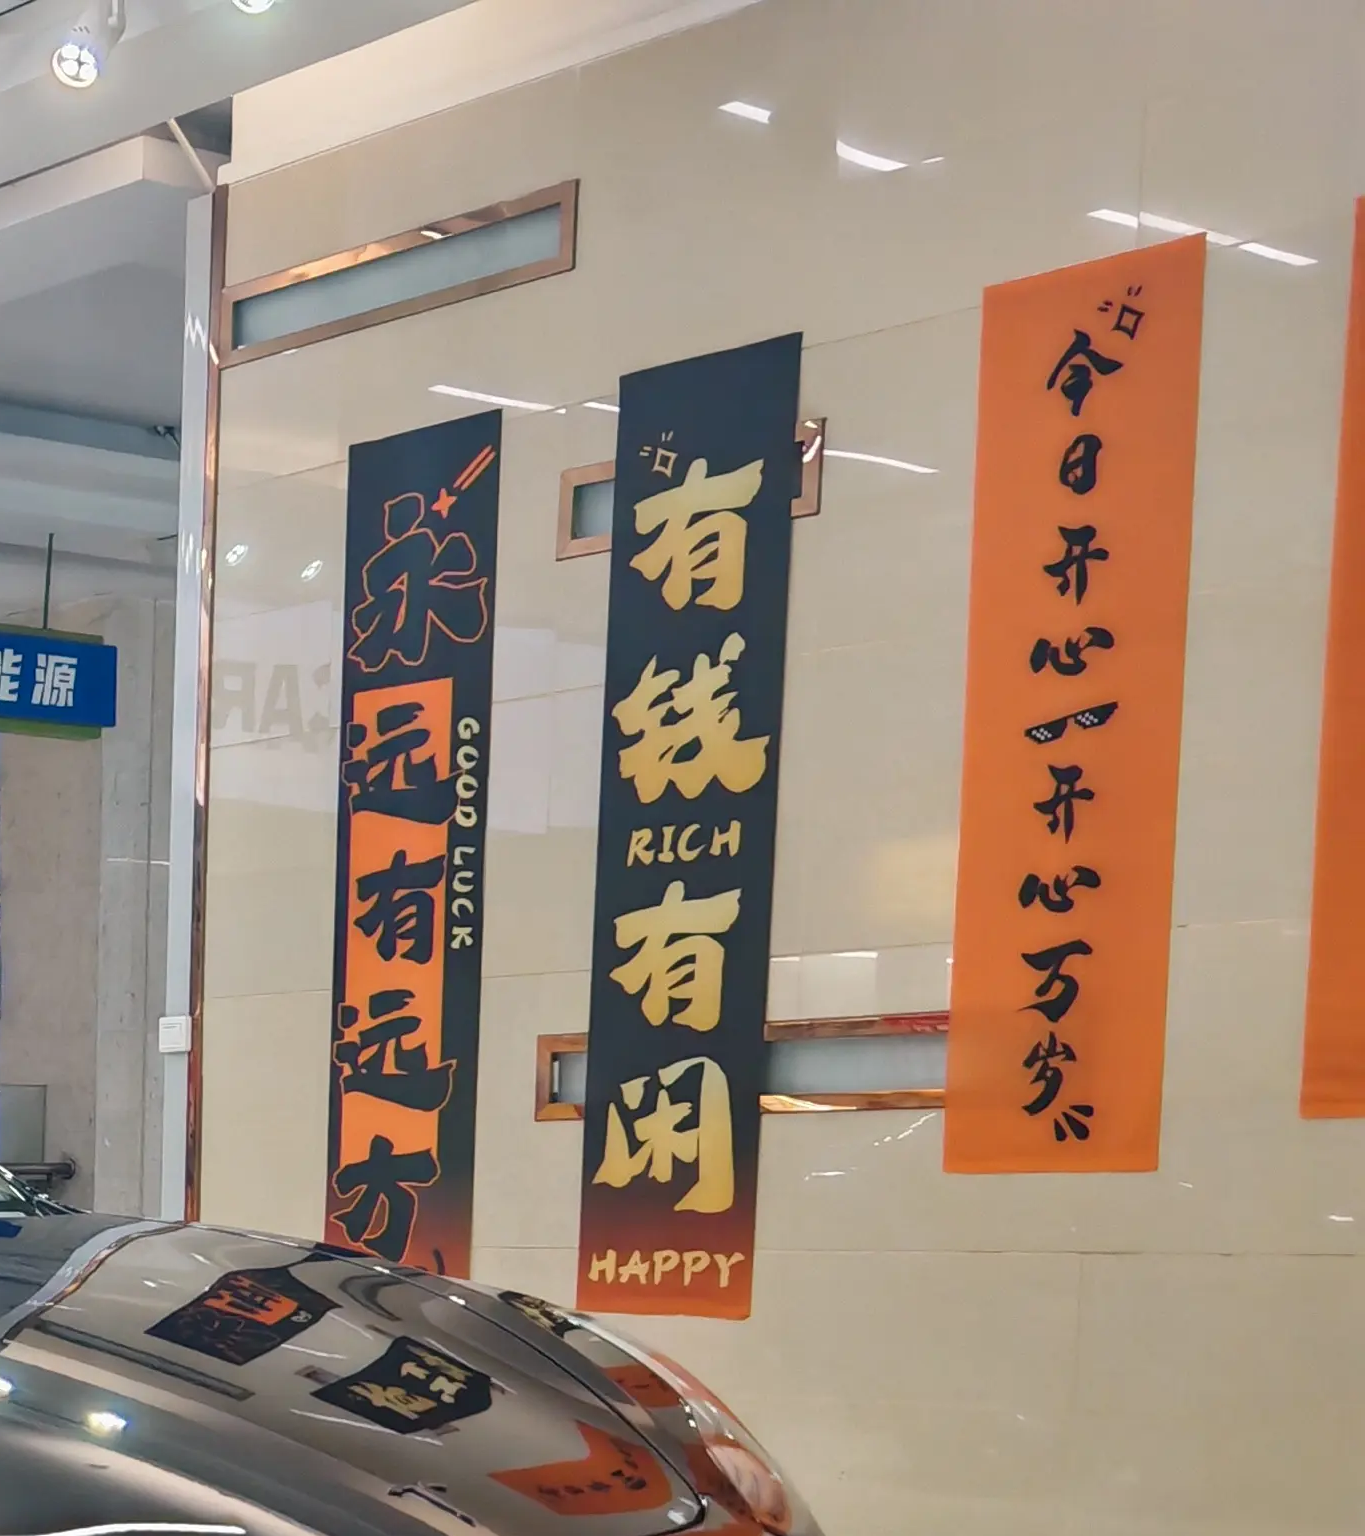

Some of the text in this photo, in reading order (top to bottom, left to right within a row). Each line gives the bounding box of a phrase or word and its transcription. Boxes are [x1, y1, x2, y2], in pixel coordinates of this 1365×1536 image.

[626, 819, 741, 867] RICH
[449, 845, 477, 951] LUCK
[587, 1249, 746, 1289] HAPPY
